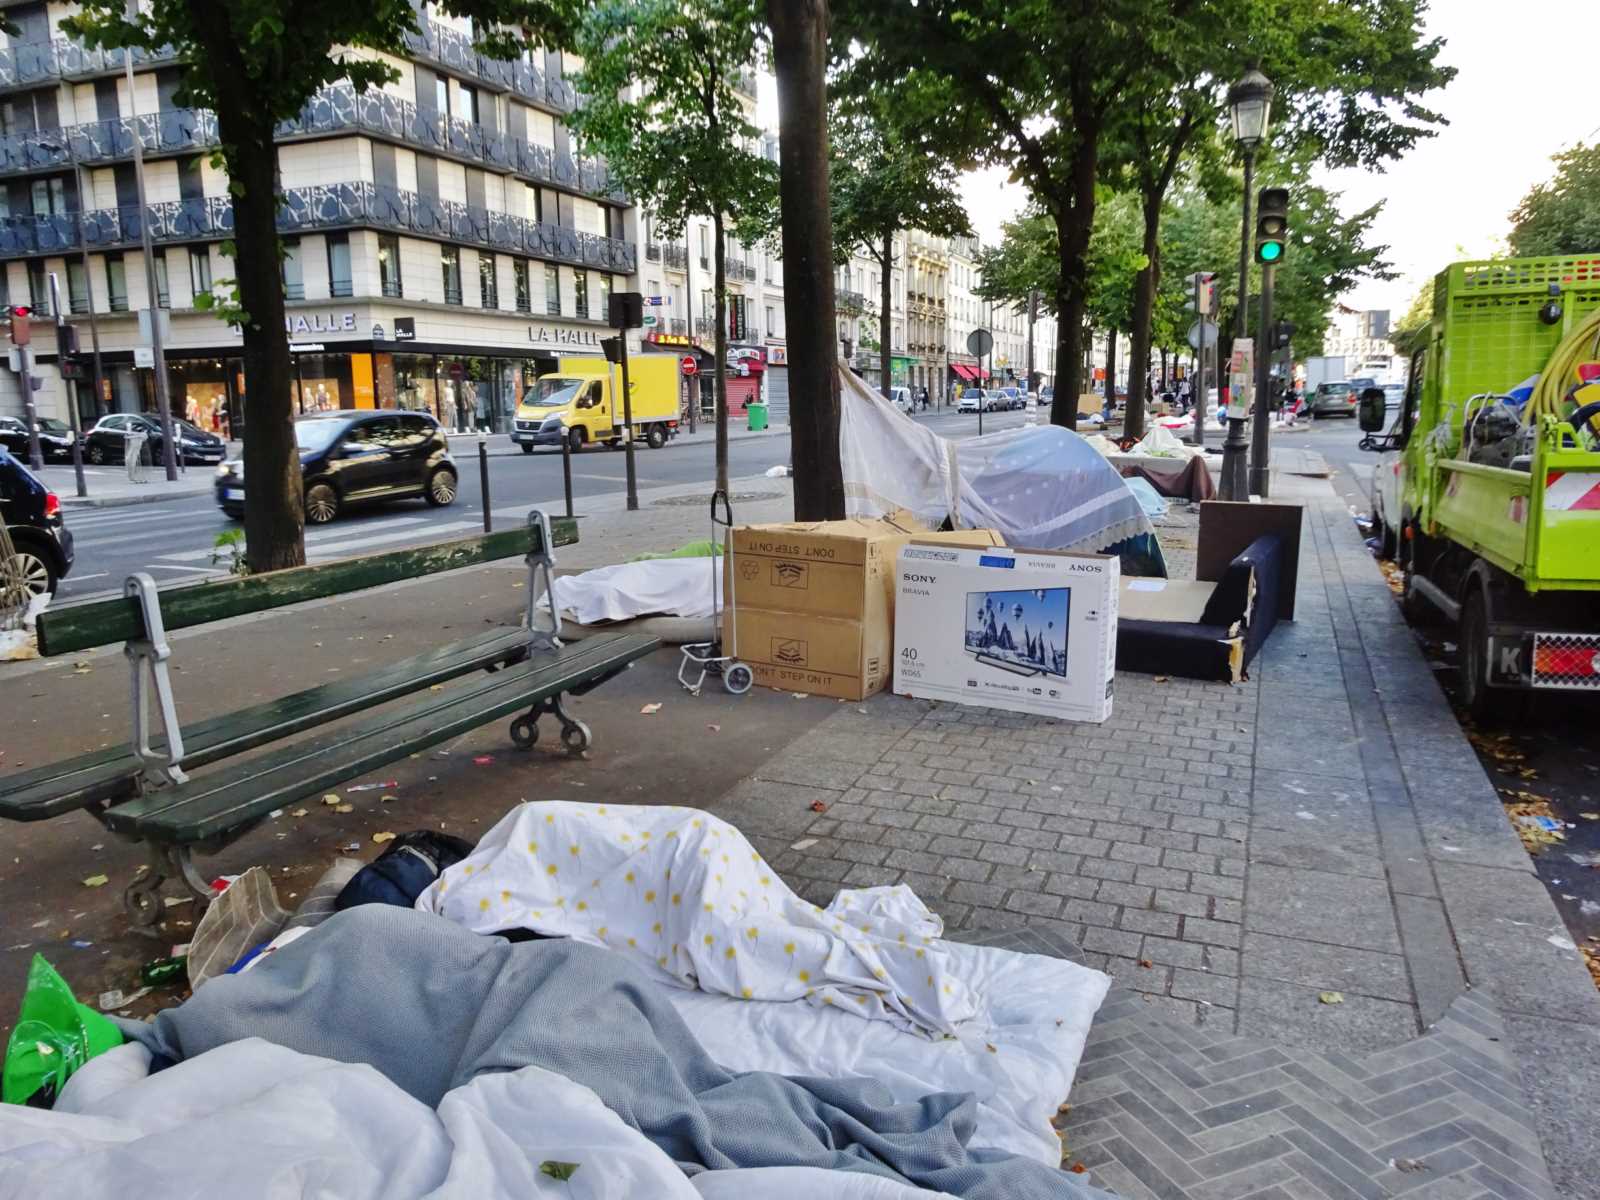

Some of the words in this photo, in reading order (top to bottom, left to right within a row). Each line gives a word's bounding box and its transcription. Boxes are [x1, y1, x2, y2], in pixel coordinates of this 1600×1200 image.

[528, 326, 549, 343] LA
[759, 543, 773, 552] ON
[775, 545, 800, 554] STEP
[1068, 563, 1103, 574] SONY
[903, 573, 937, 584] SONY
[901, 647, 918, 660] 40
[780, 670, 805, 681] STEP
[807, 674, 821, 684] ON
[823, 677, 833, 686] IT
